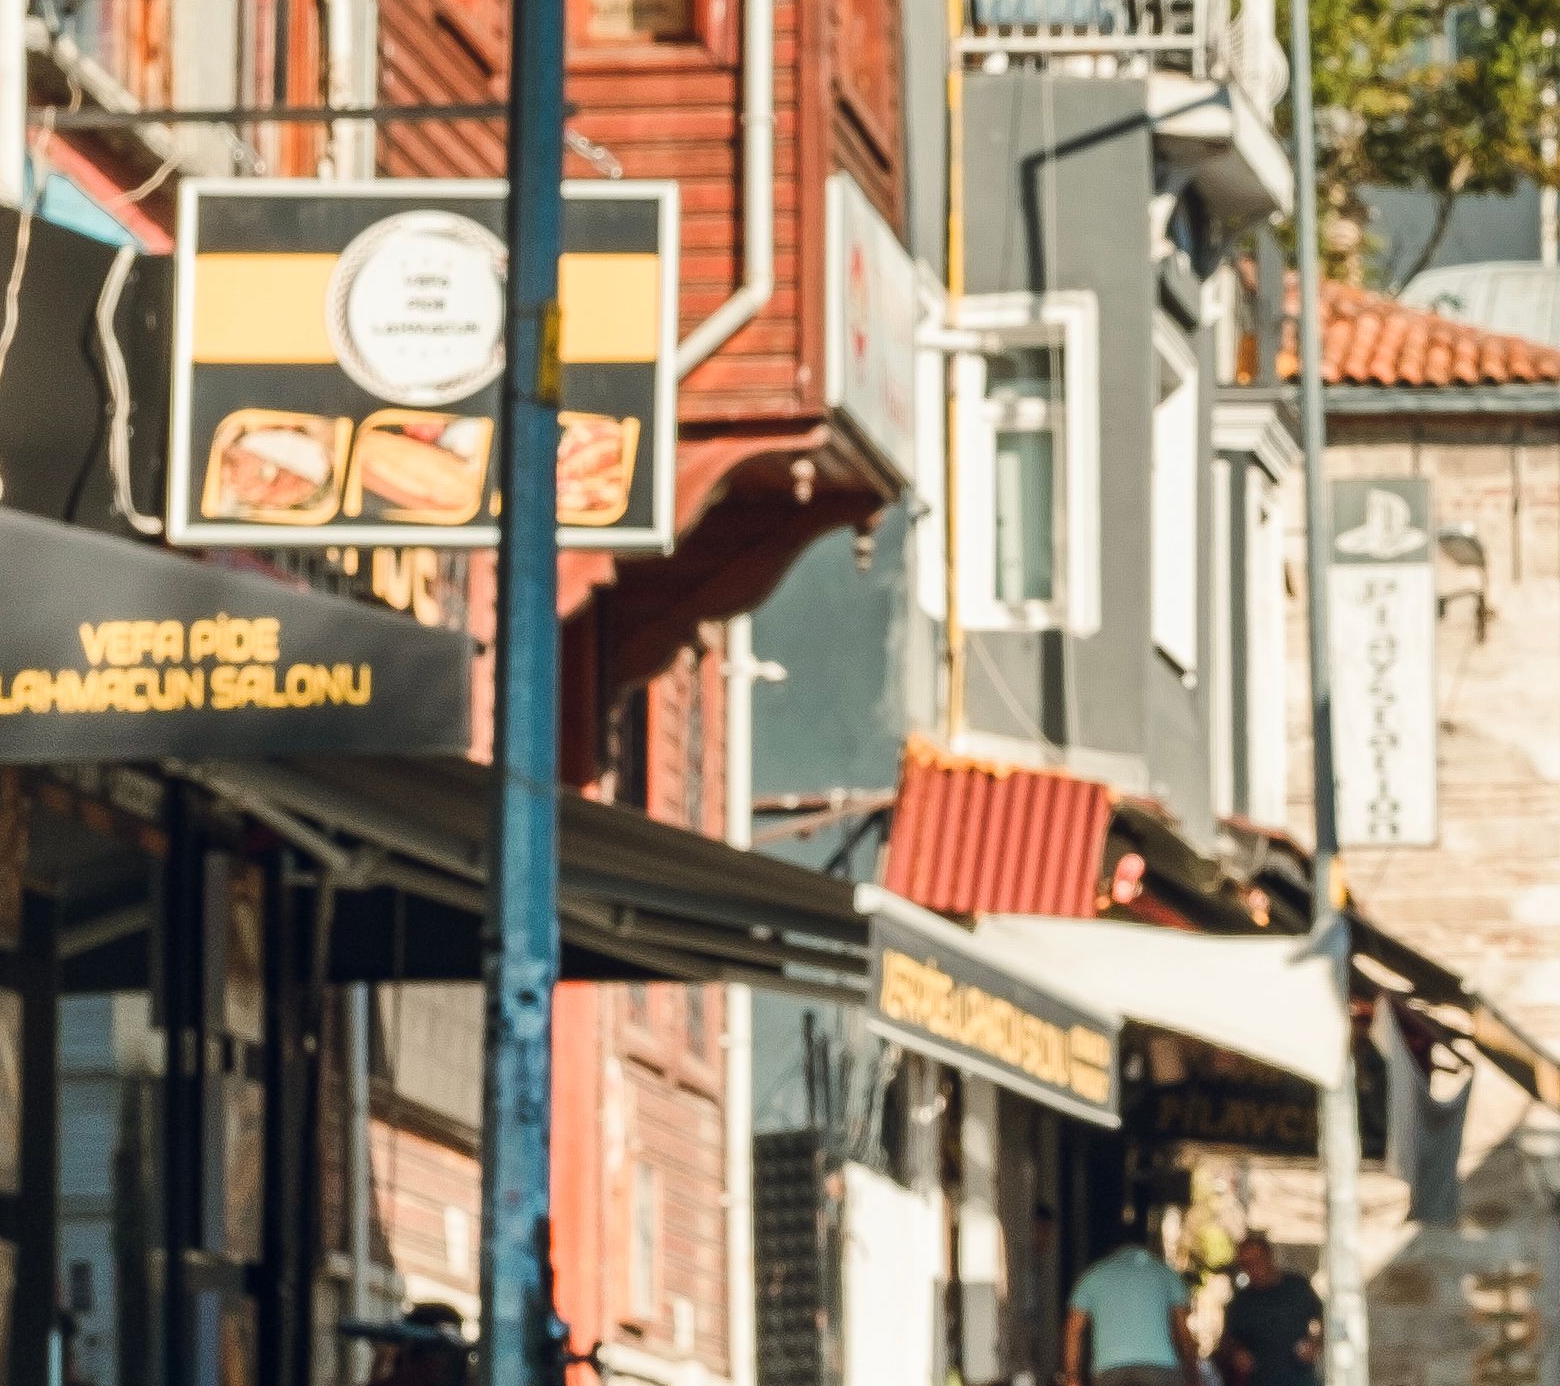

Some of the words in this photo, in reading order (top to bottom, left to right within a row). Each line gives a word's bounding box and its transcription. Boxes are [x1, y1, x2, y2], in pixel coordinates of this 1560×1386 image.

[77, 618, 186, 666] VEFA
[189, 611, 282, 664] PİDE
[209, 662, 373, 710] SALONU
